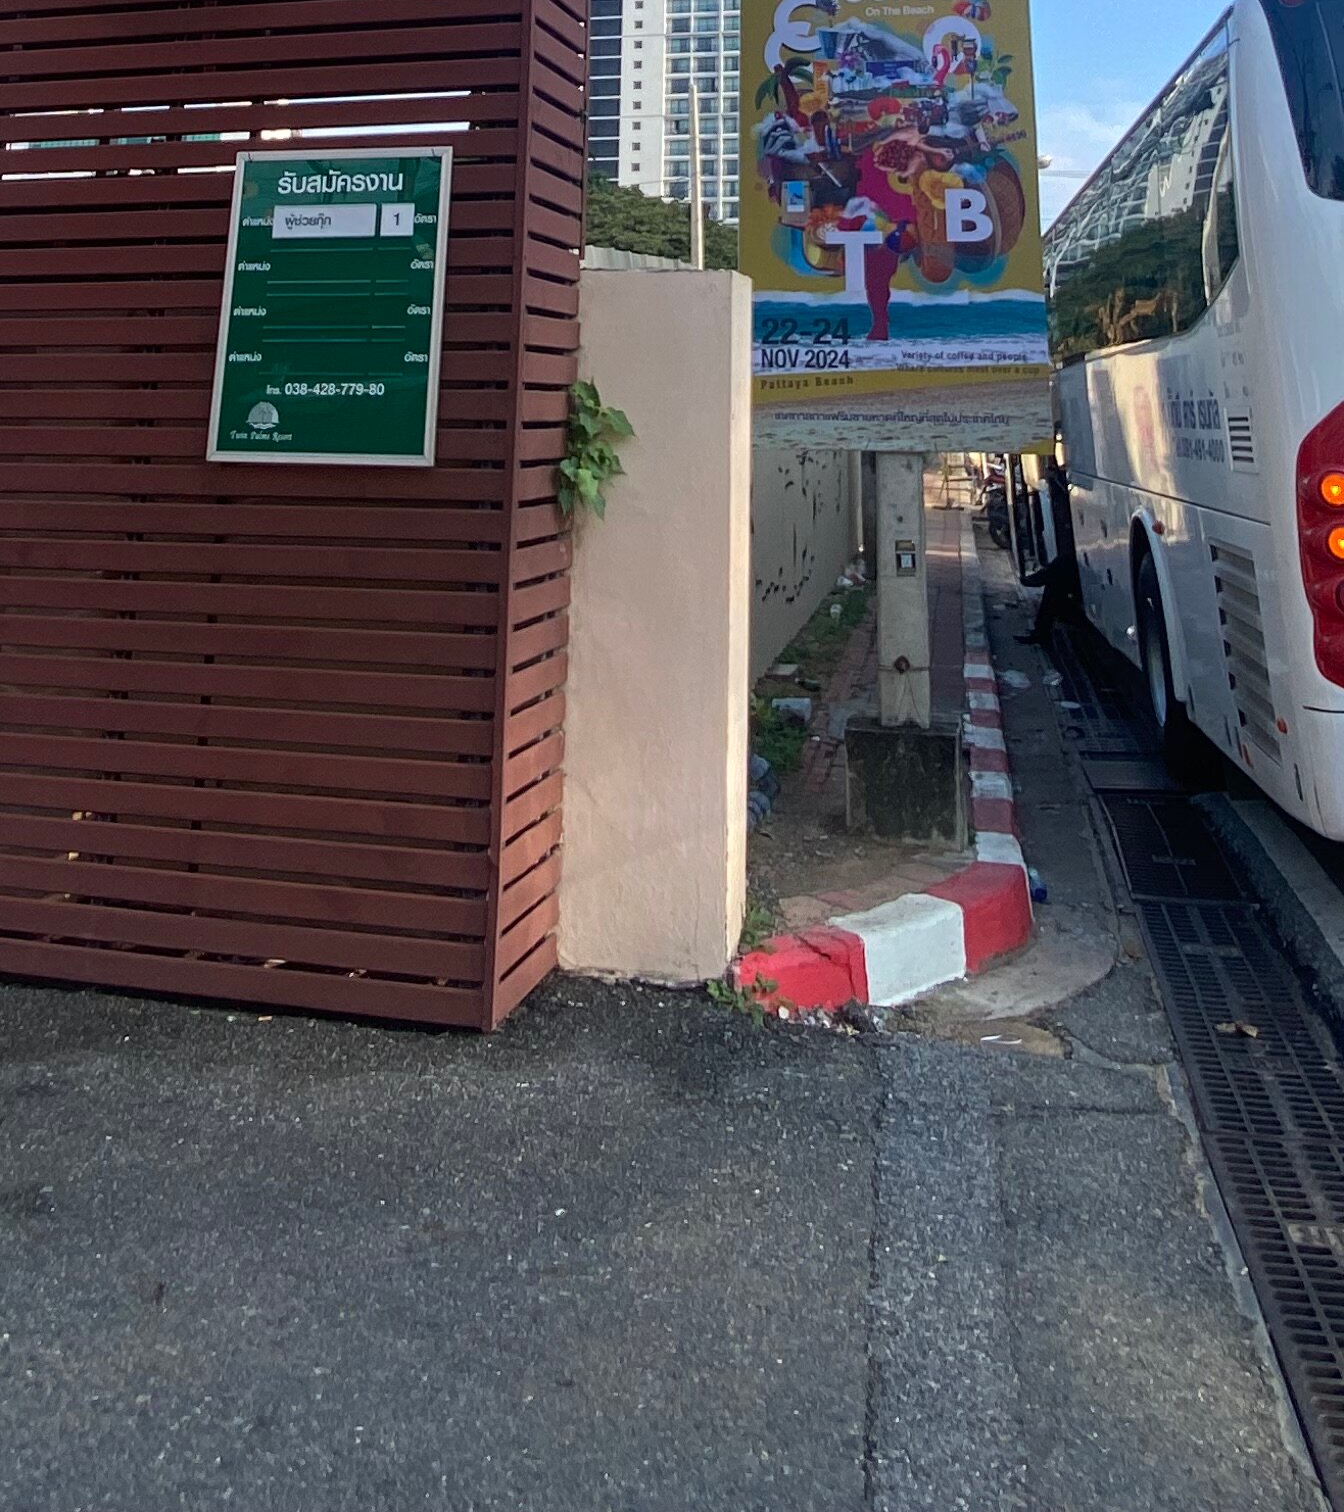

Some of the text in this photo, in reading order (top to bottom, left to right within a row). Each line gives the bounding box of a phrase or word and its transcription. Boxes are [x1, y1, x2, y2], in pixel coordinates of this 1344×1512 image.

[865, 5, 934, 17] On The Beach
[277, 170, 404, 194] รับสมัครงาน
[393, 213, 401, 226] 1
[761, 317, 850, 345] 22-24
[761, 349, 850, 369] NOV 2024
[285, 383, 385, 396] 038-428-779-80
